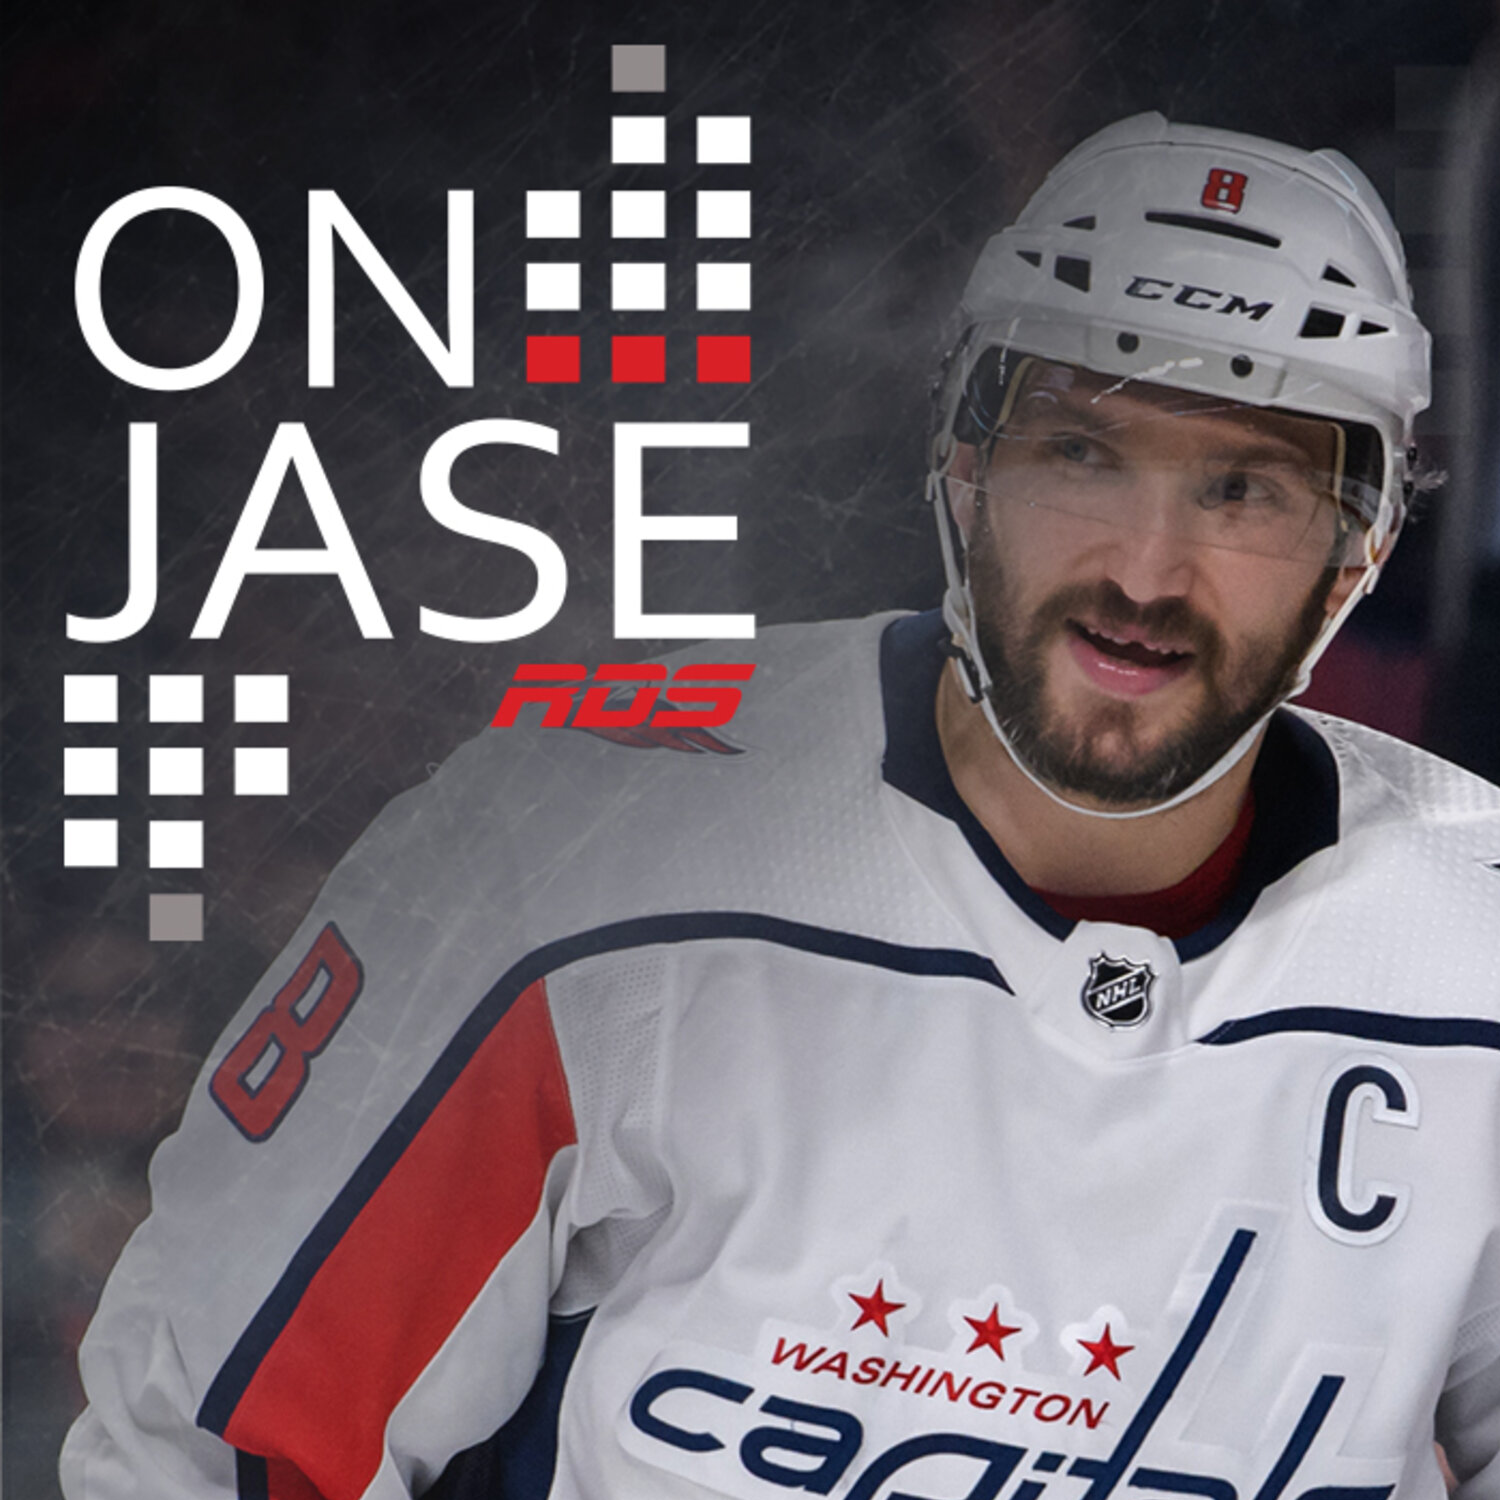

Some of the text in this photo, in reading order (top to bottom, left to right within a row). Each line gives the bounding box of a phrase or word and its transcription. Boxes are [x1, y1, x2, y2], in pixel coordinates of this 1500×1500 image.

[1201, 168, 1249, 214] 8
[1124, 275, 1274, 322] CCM
[1096, 977, 1142, 1009] NHL
[208, 920, 365, 1143] 8
[1317, 1064, 1408, 1232] C
[771, 1336, 1109, 1431] WASHINGTON
